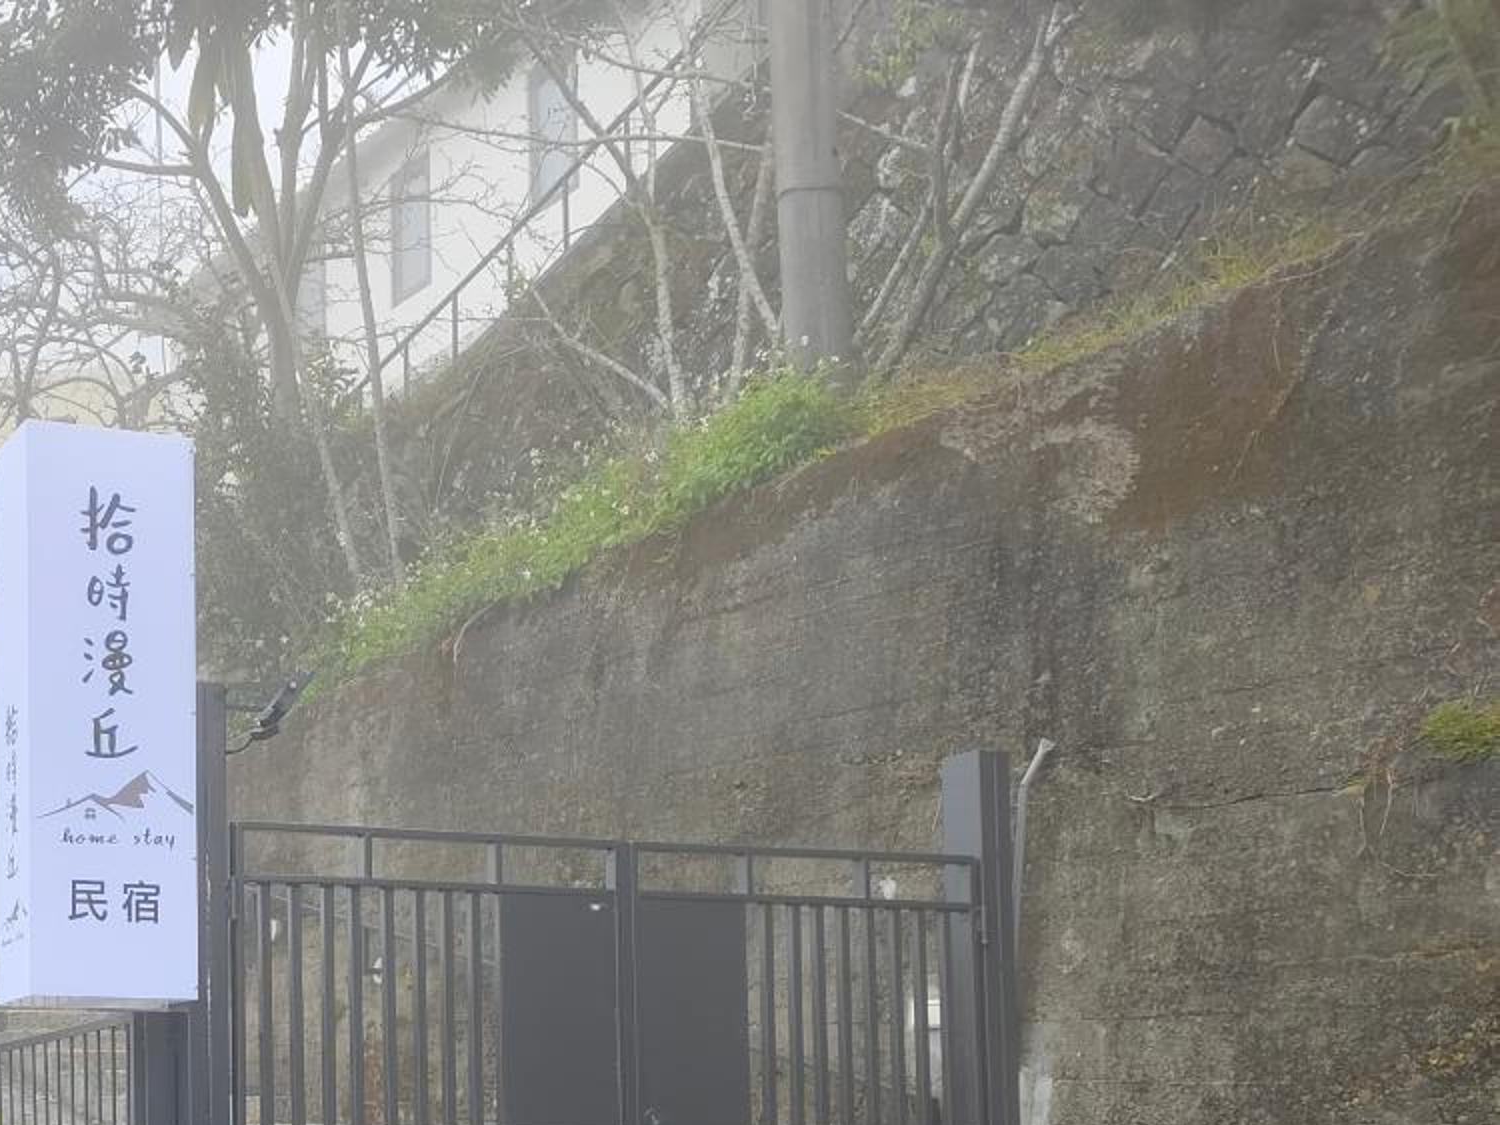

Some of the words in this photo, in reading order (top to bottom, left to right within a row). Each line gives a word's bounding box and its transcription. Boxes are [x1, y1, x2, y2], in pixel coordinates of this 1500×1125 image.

[81, 486, 137, 759] 拾時漫丘
[60, 827, 117, 845] home
[132, 827, 176, 849] stay
[68, 879, 161, 924] 民宿
